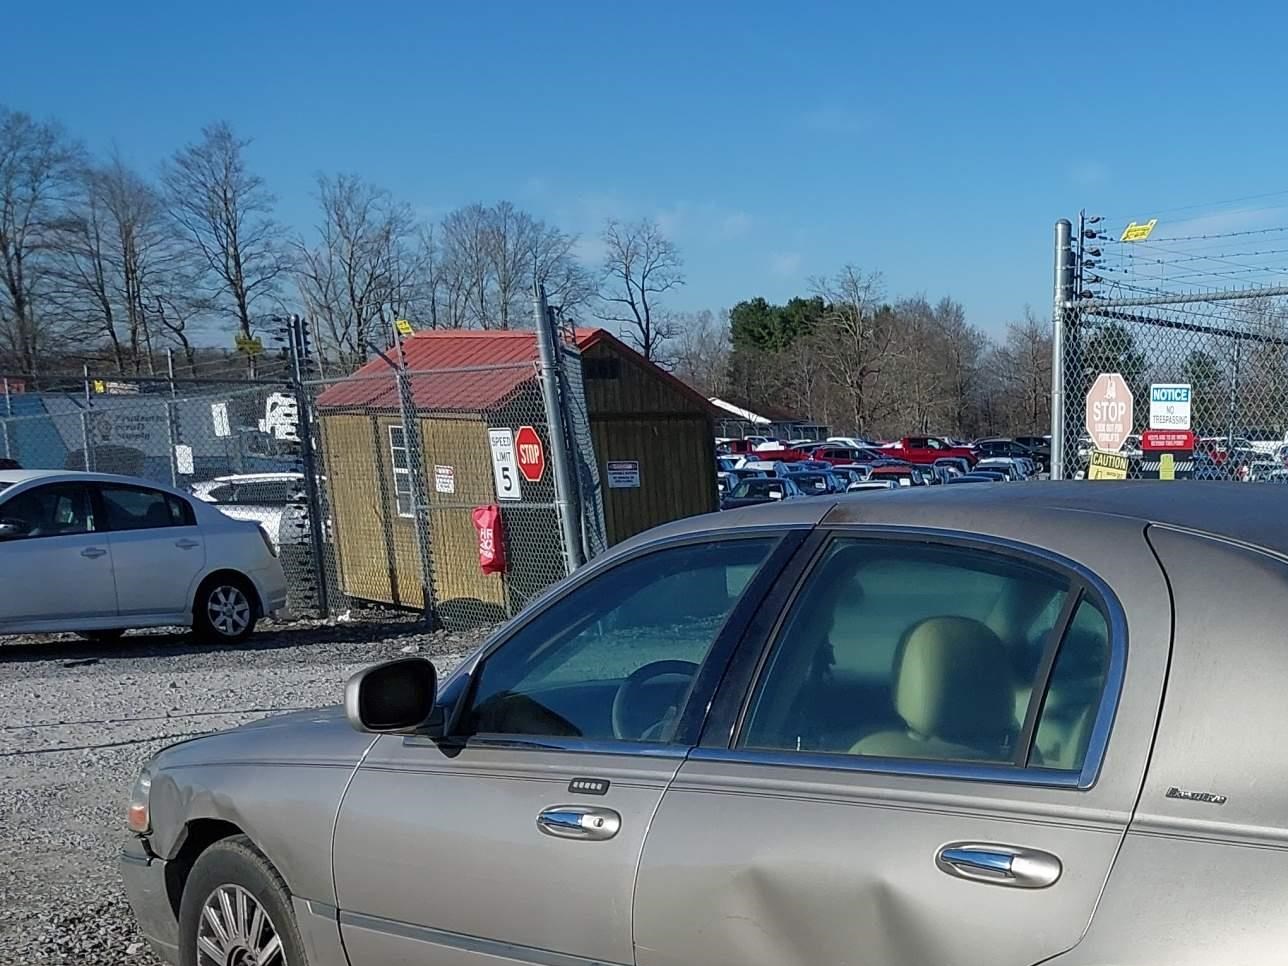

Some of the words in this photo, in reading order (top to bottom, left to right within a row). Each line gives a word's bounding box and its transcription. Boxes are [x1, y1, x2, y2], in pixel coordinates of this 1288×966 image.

[1153, 388, 1188, 401] NOTICE
[1093, 401, 1126, 421] STOP
[1166, 405, 1175, 415] NO
[1152, 415, 1188, 425] TRESPASSING
[491, 436, 511, 447] SPEED
[496, 452, 511, 463] LIMIT
[520, 444, 540, 465] STOP
[1093, 453, 1126, 470] CAUTION
[501, 466, 513, 492] 5
